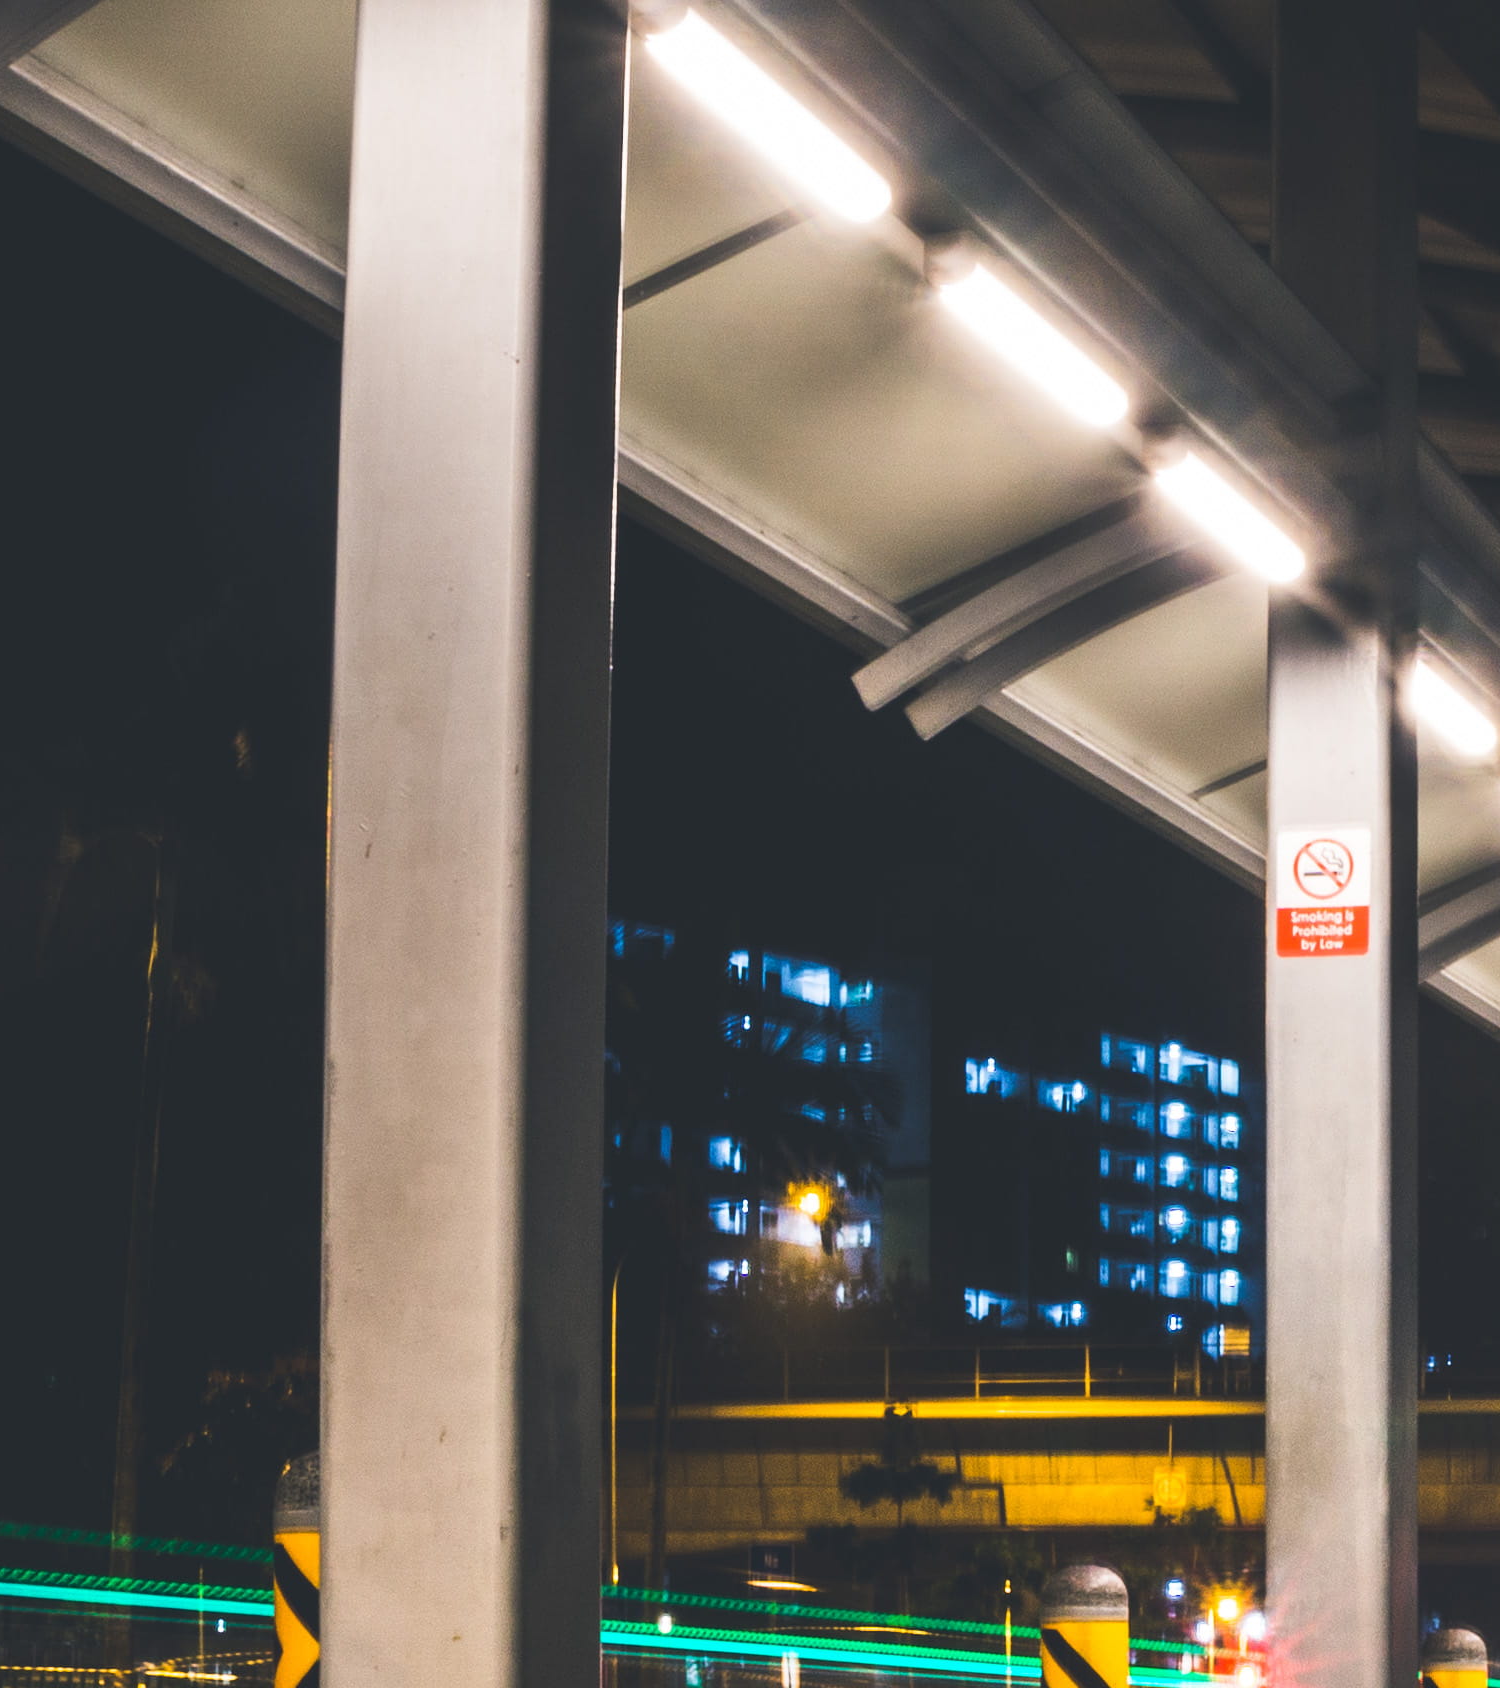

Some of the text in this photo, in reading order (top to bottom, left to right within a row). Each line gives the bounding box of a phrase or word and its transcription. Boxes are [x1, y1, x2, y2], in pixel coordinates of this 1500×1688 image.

[1291, 910, 1354, 924] Smoking is
[1292, 924, 1353, 937] Prohibited
[1301, 938, 1344, 952] by Law
